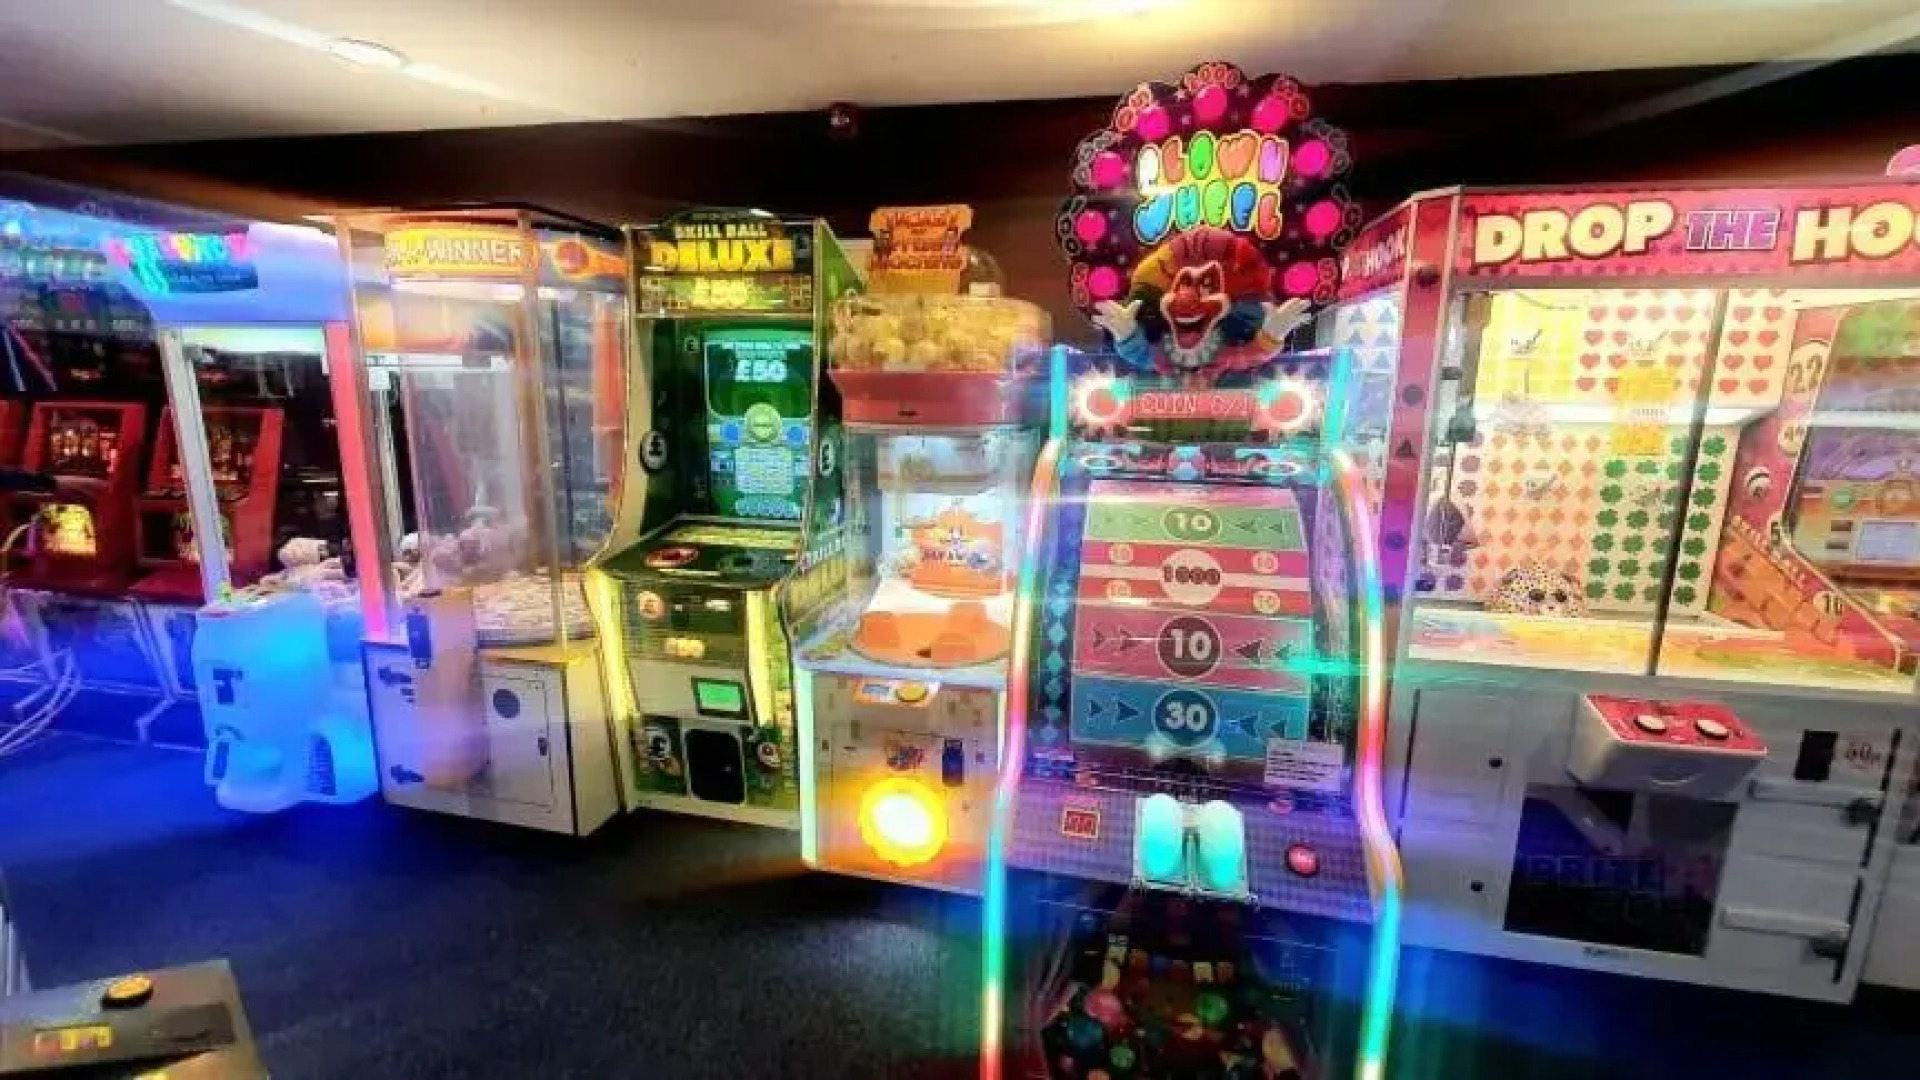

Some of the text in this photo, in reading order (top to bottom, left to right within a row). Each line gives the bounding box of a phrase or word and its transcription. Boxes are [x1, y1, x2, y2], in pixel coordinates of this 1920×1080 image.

[1136, 128, 1290, 201] CLOWN
[1133, 178, 1283, 245] WHEEL
[726, 223, 768, 238] BALL
[1471, 199, 1920, 268] DROP THE HO
[426, 239, 522, 264] WINNER
[650, 239, 795, 272] DELUXE
[1141, 393, 1197, 414] COIN
[1174, 512, 1212, 532] 10
[1162, 566, 1222, 586] 1000
[1170, 628, 1213, 662] 10
[1163, 701, 1209, 731] 30
